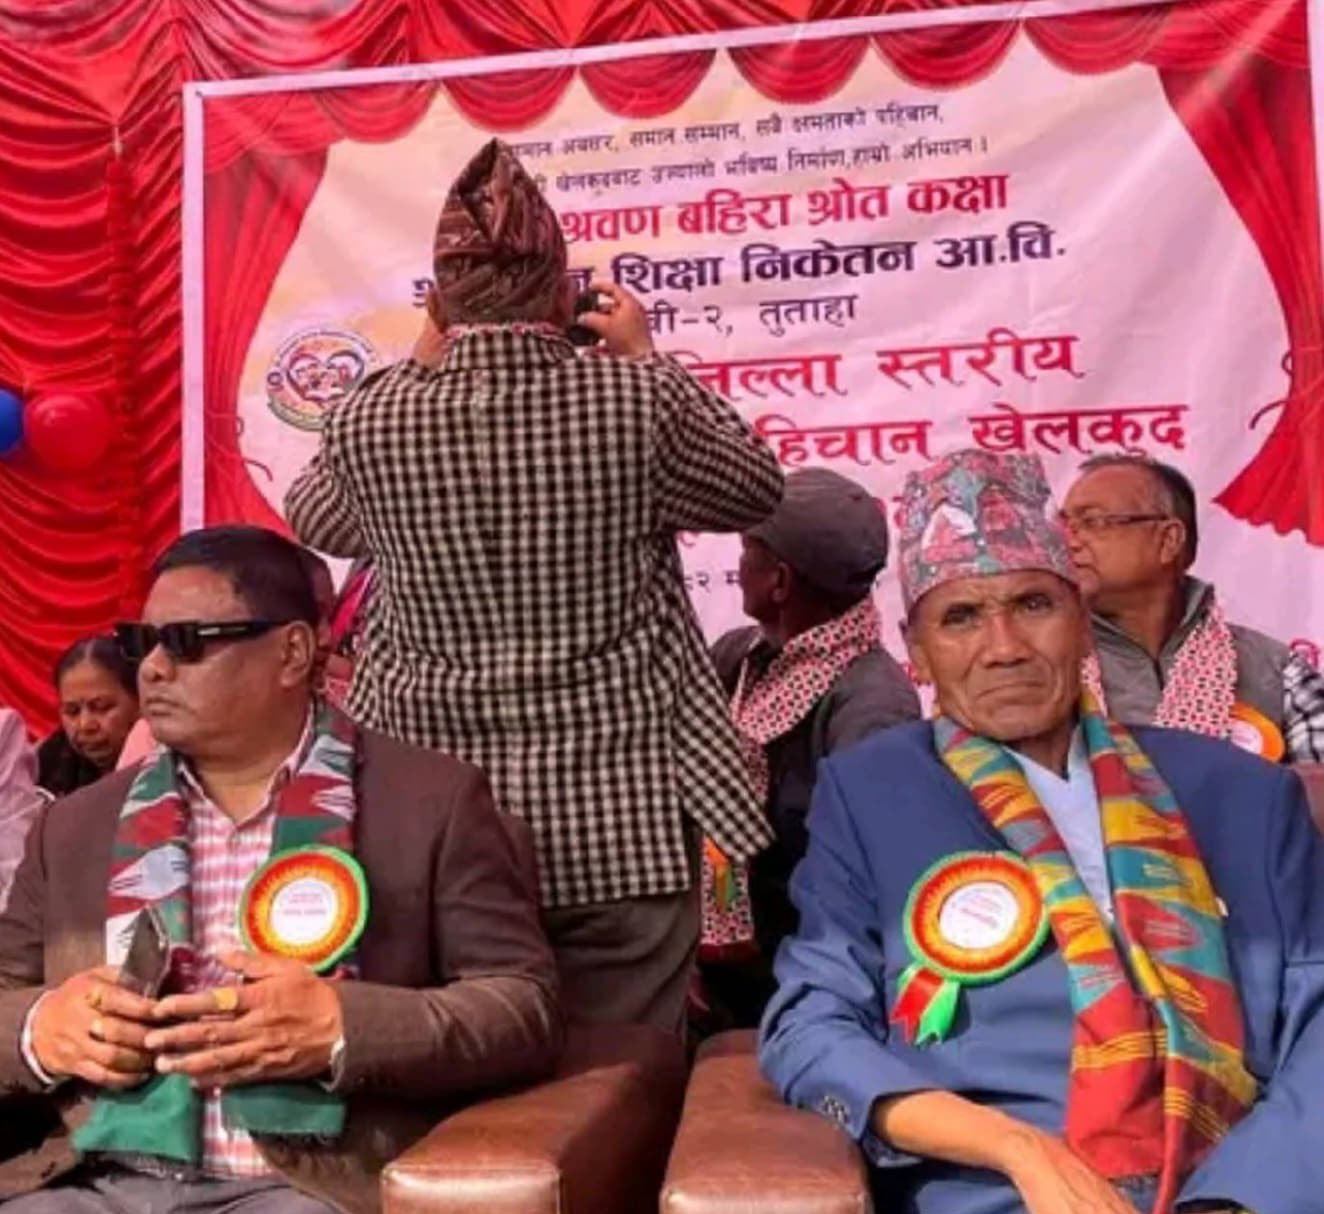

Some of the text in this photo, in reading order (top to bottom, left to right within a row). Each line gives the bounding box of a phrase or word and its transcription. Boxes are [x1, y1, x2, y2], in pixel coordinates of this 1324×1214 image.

[676, 186, 793, 235] बहिरा
[807, 176, 892, 227] श्रोत
[905, 173, 1010, 215] कक्षा
[611, 250, 724, 295] शिक्षा
[741, 239, 918, 284] निकेतन
[758, 293, 859, 338] तुताहा
[876, 327, 1086, 389] स्तरीय
[754, 402, 1189, 465] हिचान खेलकुद
